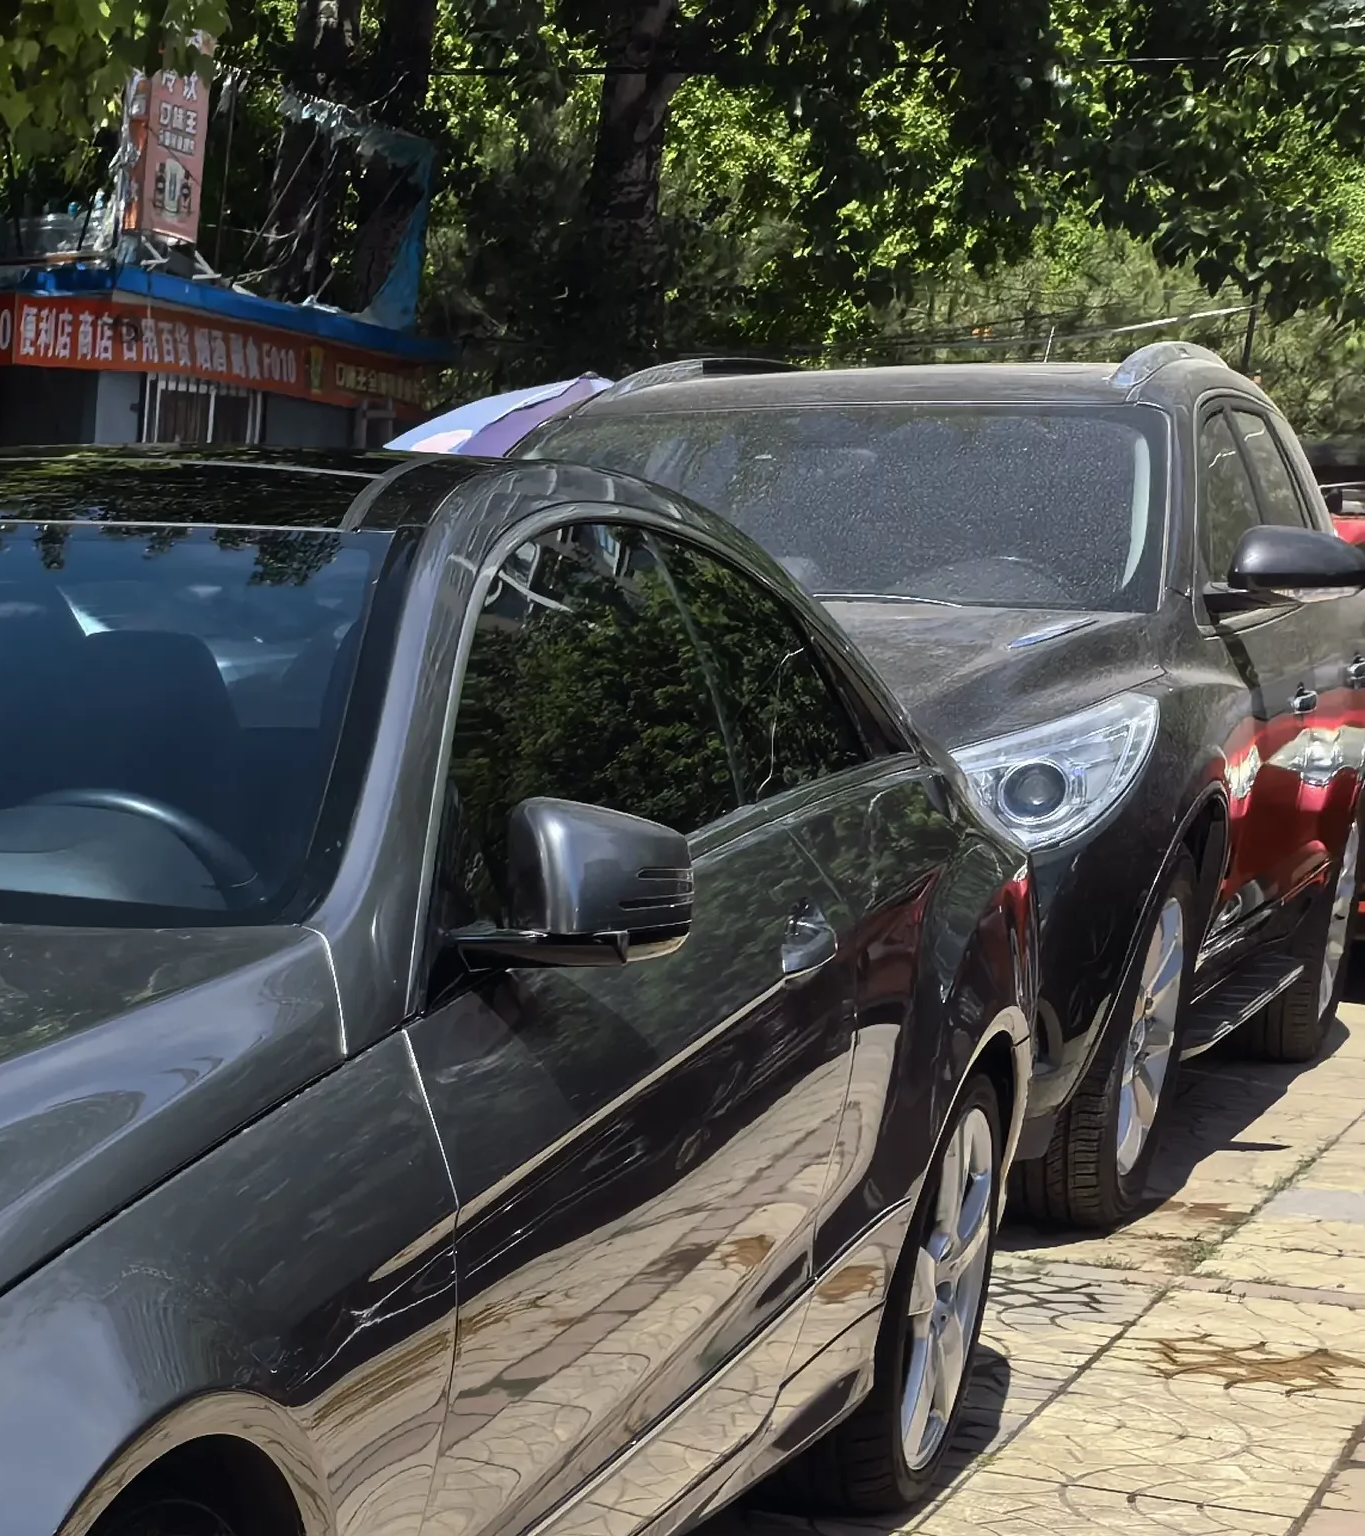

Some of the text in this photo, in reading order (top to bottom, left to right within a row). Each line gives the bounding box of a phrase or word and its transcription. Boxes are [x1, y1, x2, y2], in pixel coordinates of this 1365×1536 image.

[19, 304, 73, 359] 便利店
[77, 311, 114, 361] 商店
[262, 343, 296, 384] F010
